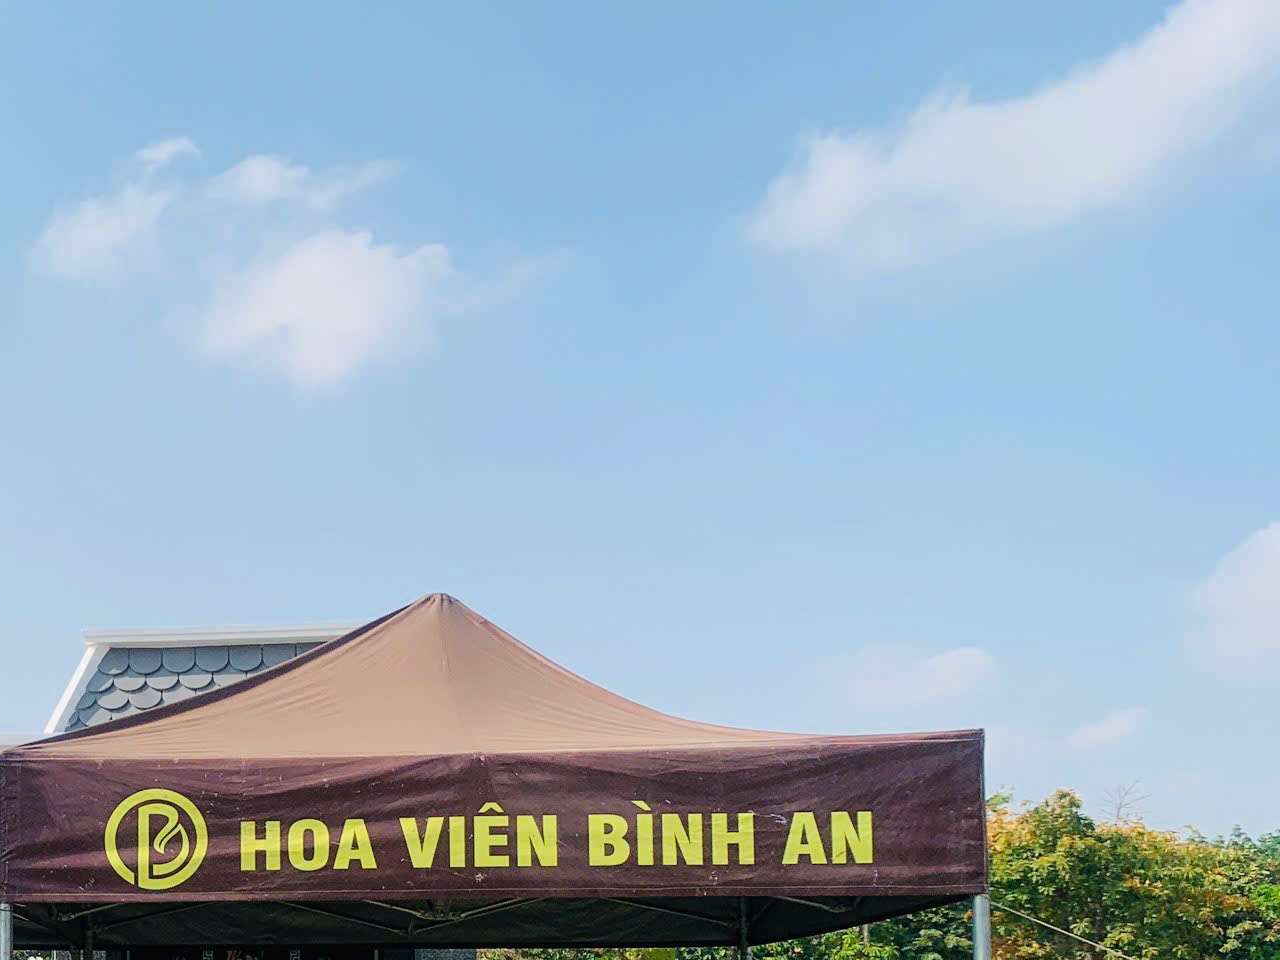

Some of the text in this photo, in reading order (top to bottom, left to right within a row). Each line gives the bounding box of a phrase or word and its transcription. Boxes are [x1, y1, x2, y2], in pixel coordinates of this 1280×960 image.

[239, 801, 873, 871] HOA VIÊN BÌNH AN
